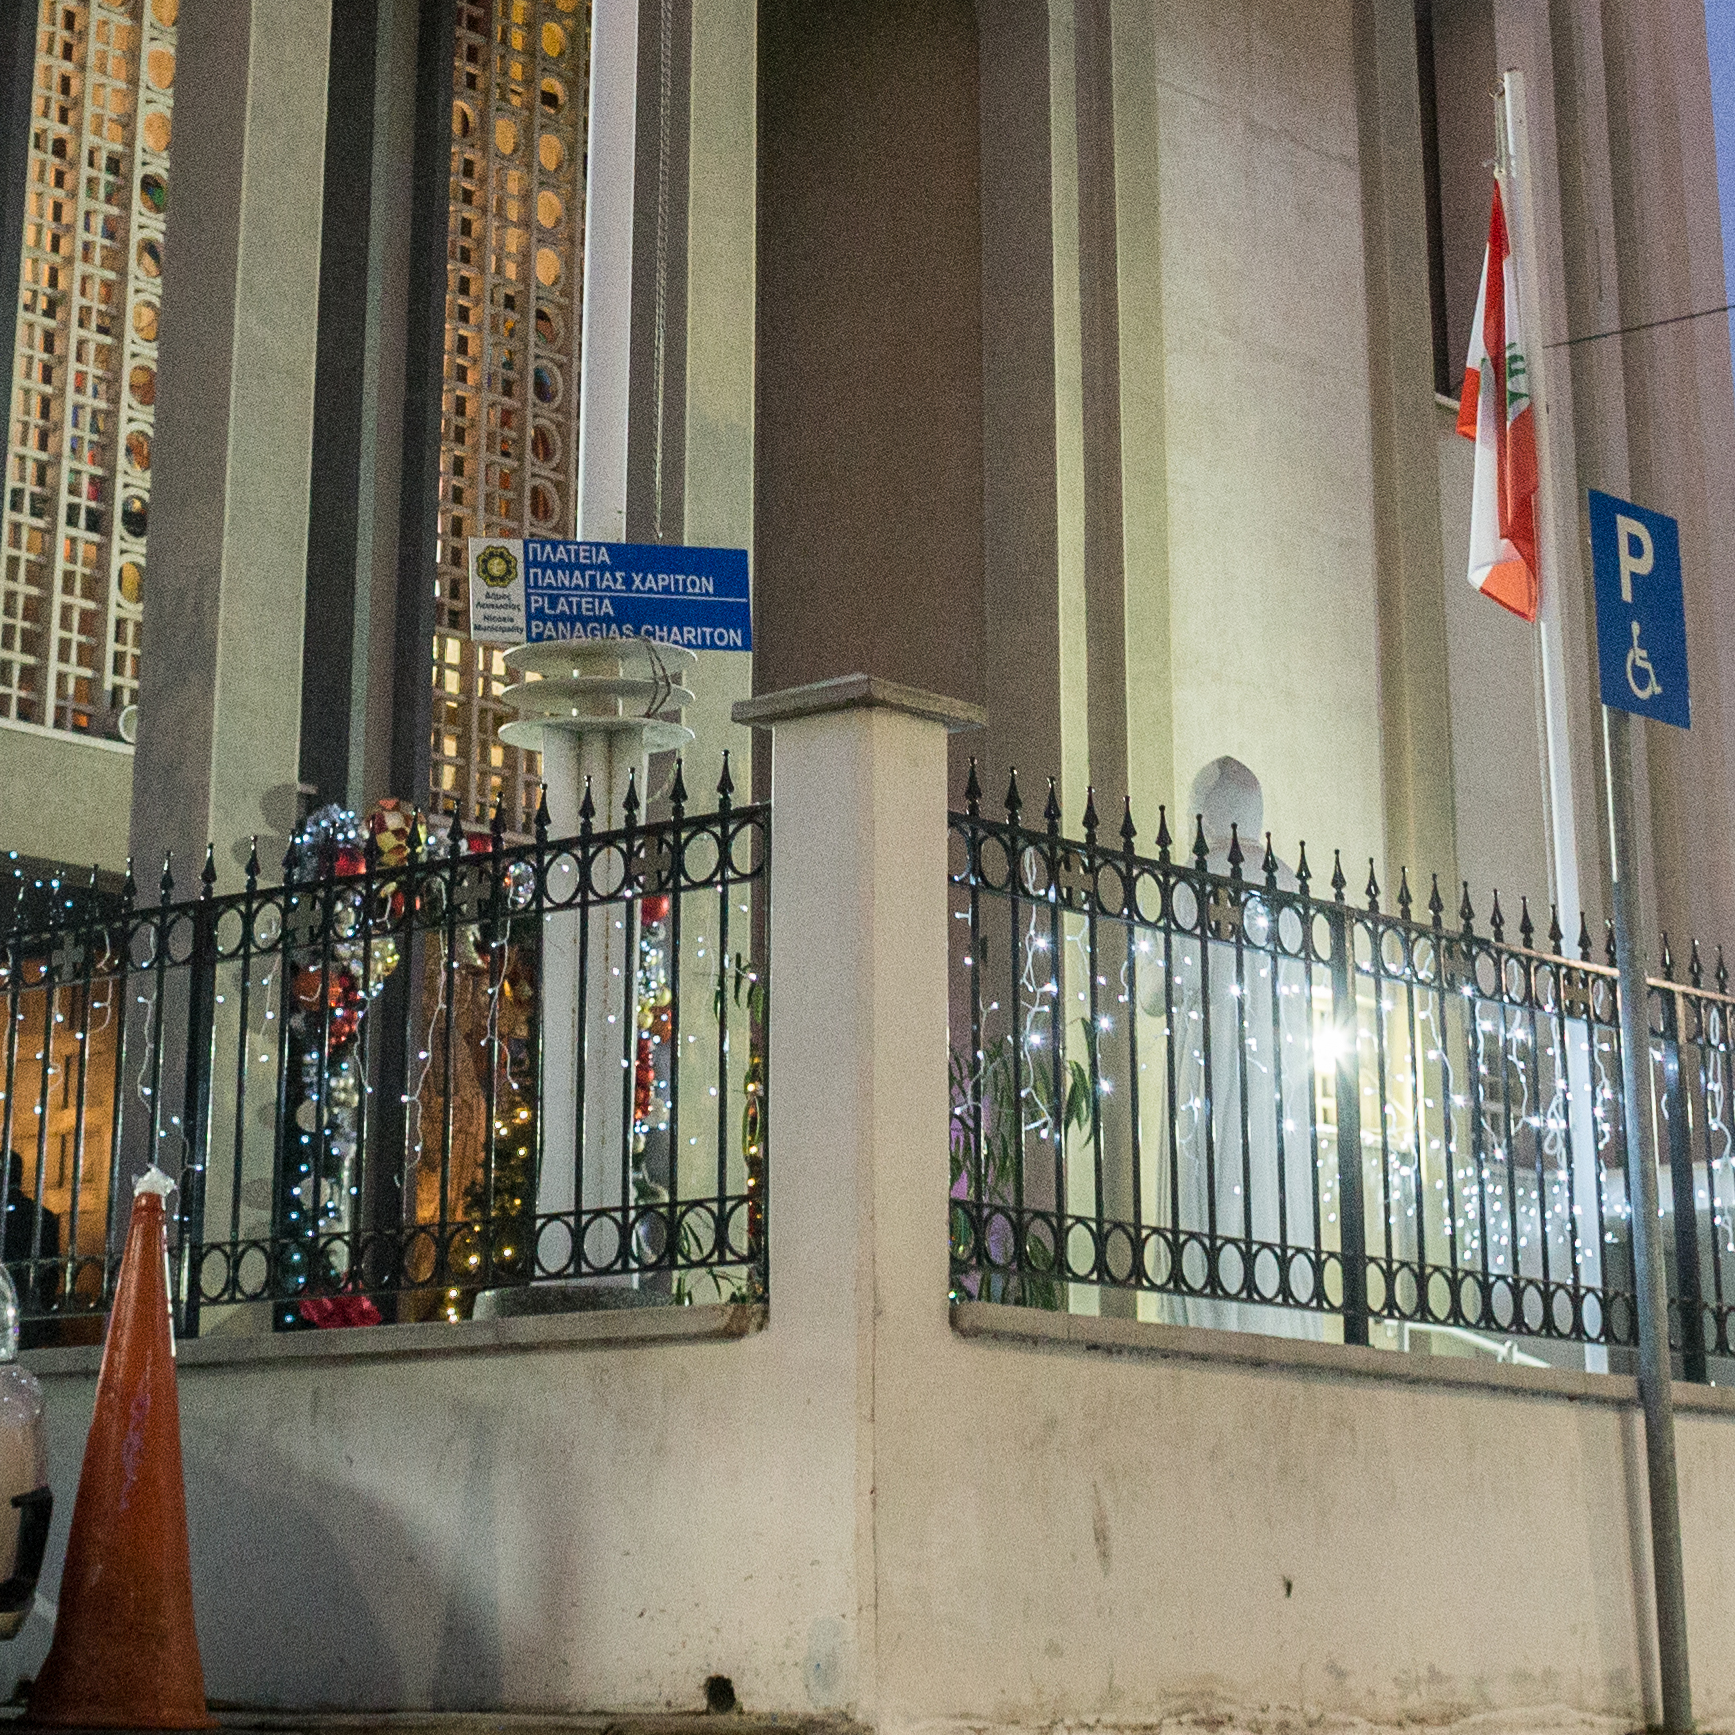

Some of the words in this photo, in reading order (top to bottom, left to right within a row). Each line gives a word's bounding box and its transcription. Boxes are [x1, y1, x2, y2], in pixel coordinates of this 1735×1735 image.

[528, 543, 611, 565] ΠΛΑΤΕΙΑ
[1616, 513, 1654, 604] P
[528, 568, 627, 590] ΠΑΝΑΓΙΑΣ
[631, 572, 714, 594] ΧΑΡΙΤΩΝ
[530, 595, 614, 617] PLATEIA
[640, 626, 742, 647] CHARITON
